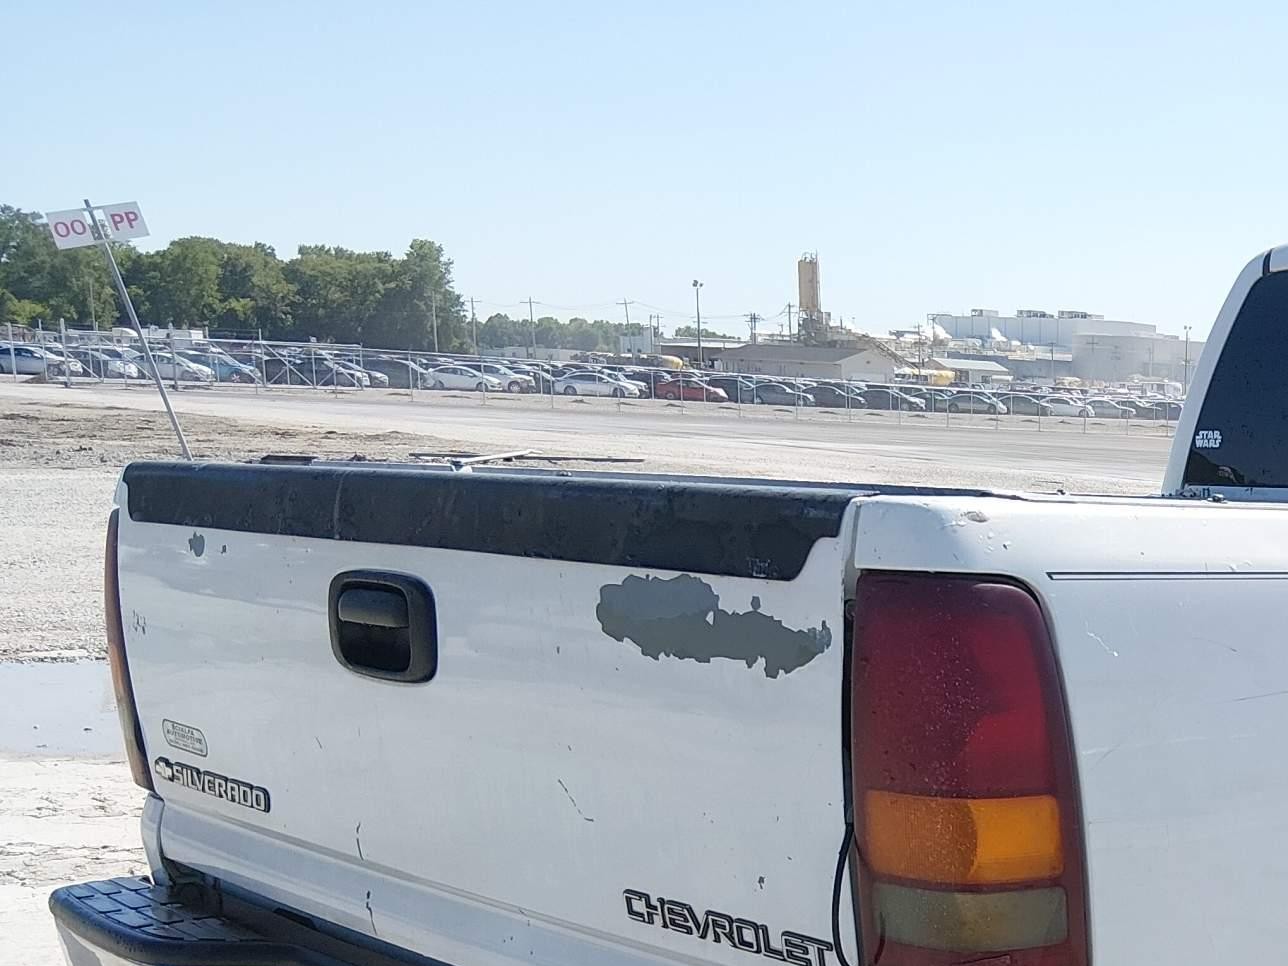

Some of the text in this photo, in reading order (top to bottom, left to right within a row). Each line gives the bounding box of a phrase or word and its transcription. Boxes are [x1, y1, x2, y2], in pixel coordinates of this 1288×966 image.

[53, 219, 87, 238] OO
[110, 211, 139, 232] PP
[1195, 430, 1222, 439] STAR
[1195, 439, 1222, 448] WARS
[172, 762, 270, 813] SILVERADO
